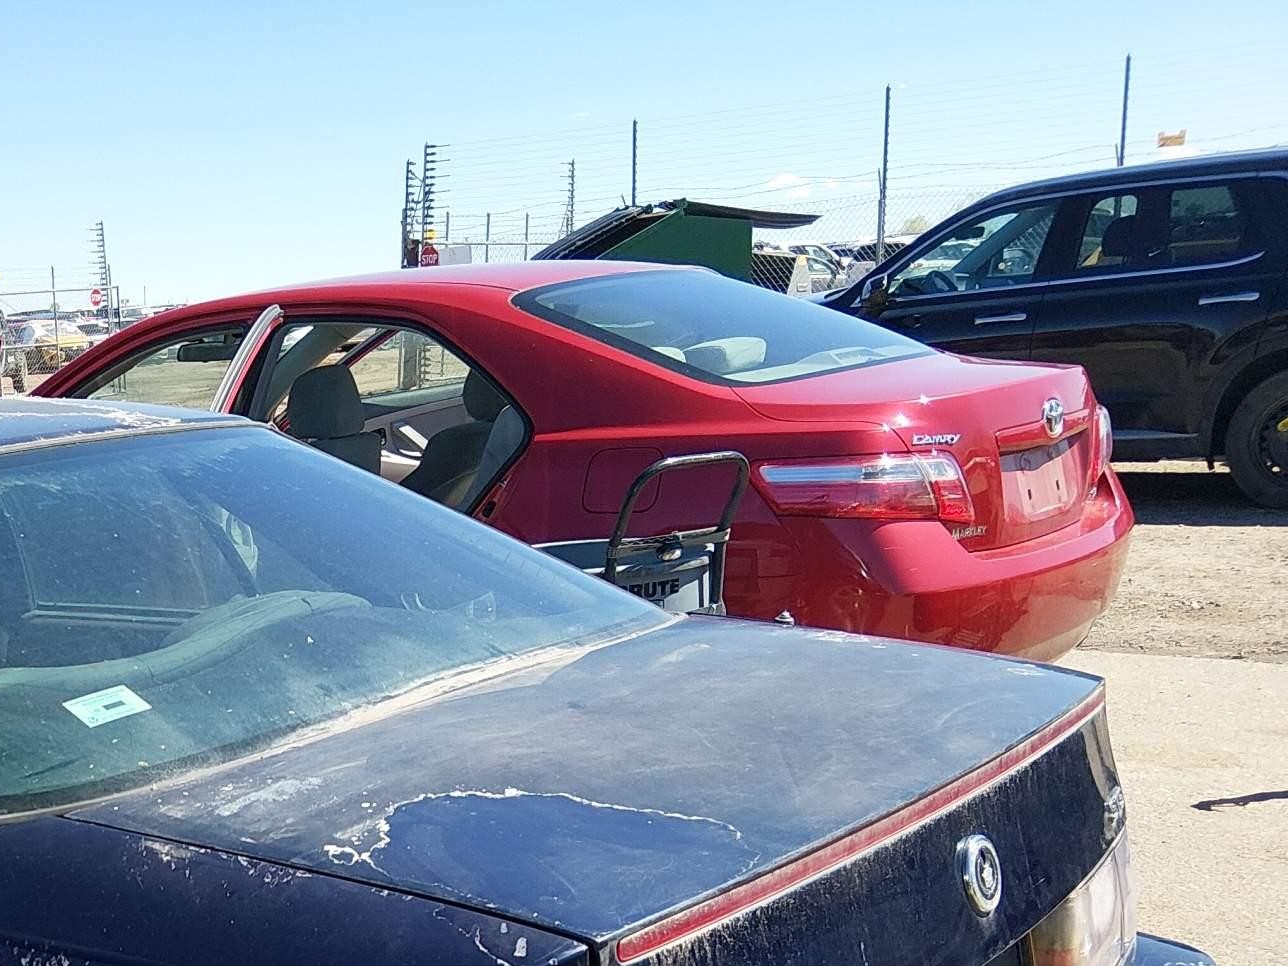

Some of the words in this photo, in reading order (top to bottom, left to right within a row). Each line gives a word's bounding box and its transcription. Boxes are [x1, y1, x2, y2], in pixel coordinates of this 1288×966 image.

[421, 254, 438, 265] STOP
[912, 432, 961, 445] CAMRY
[618, 578, 680, 599] RUTE
